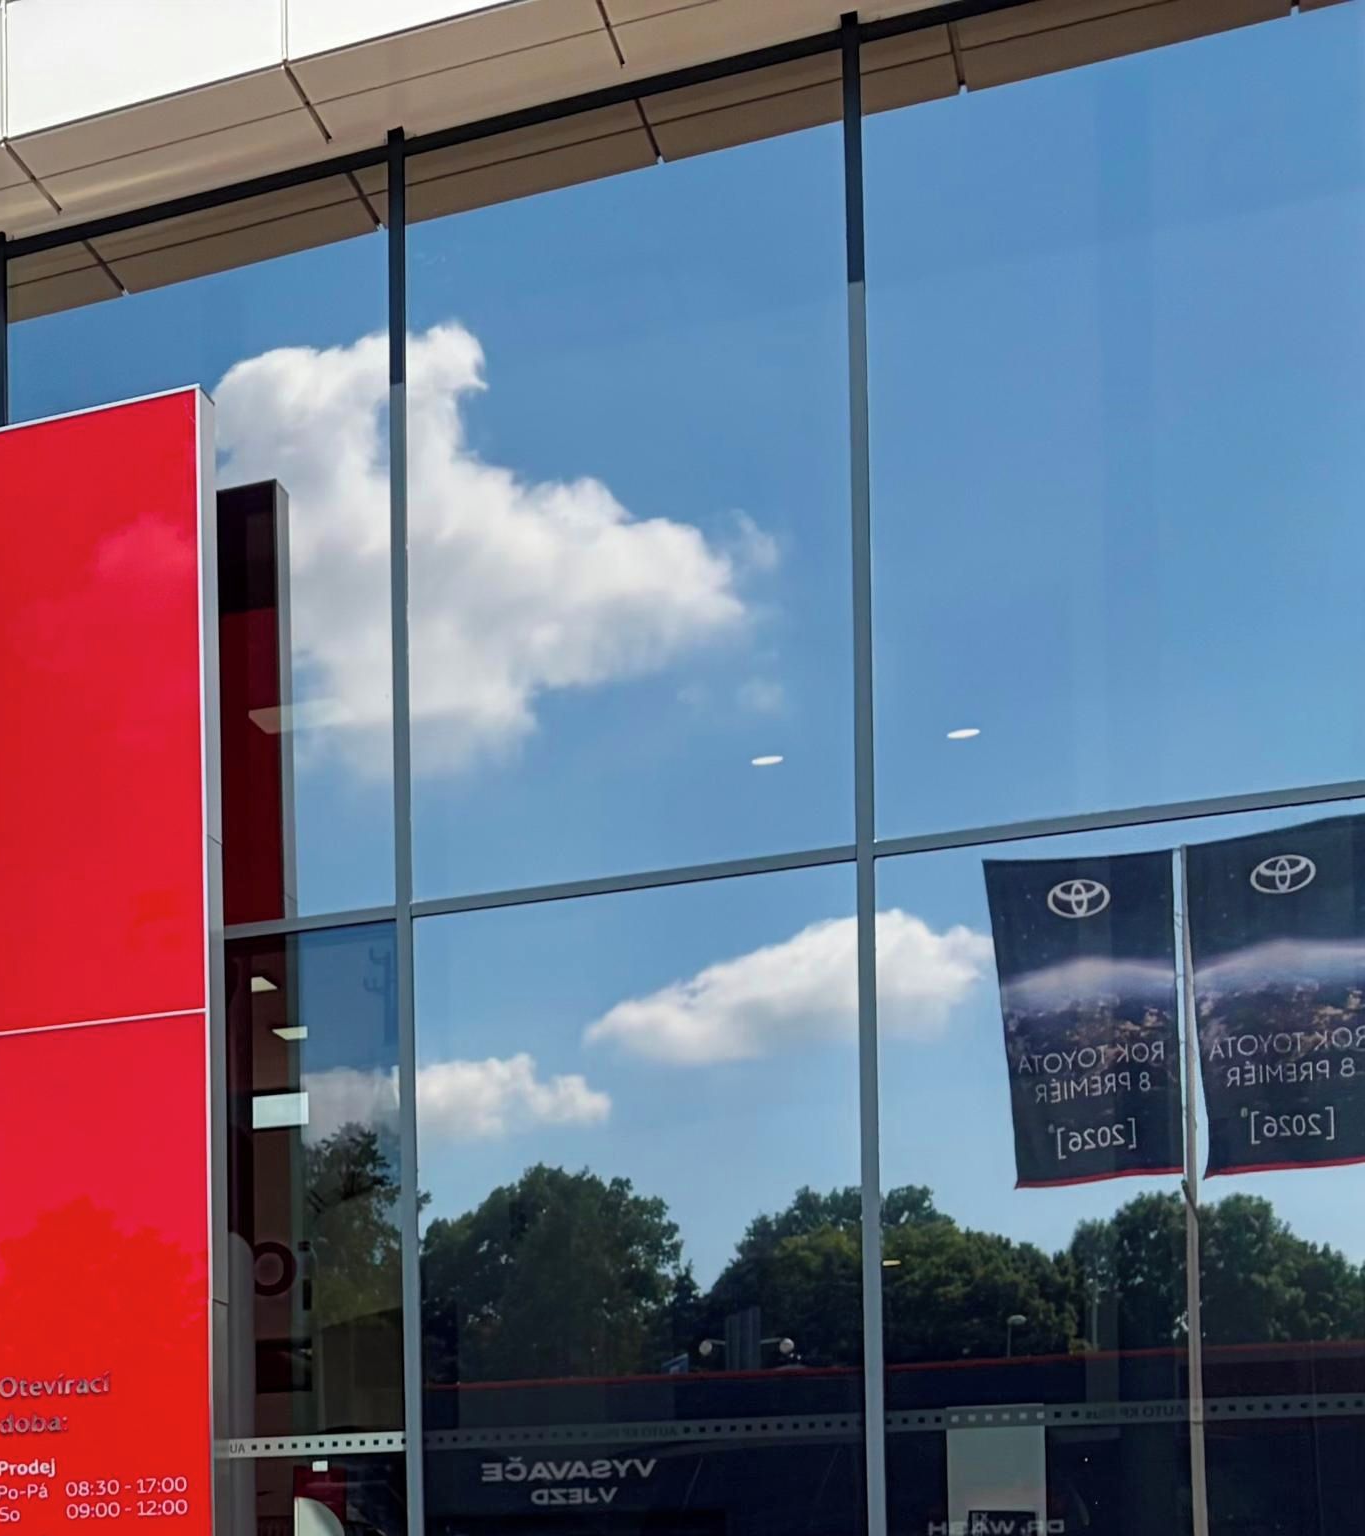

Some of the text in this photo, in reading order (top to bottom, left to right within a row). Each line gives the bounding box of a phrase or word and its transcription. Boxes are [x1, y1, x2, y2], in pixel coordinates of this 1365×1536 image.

[65, 1480, 119, 1498] 08:30
[136, 1476, 188, 1494] 17:00
[66, 1502, 120, 1520] 09:00
[137, 1498, 188, 1516] 12:00
